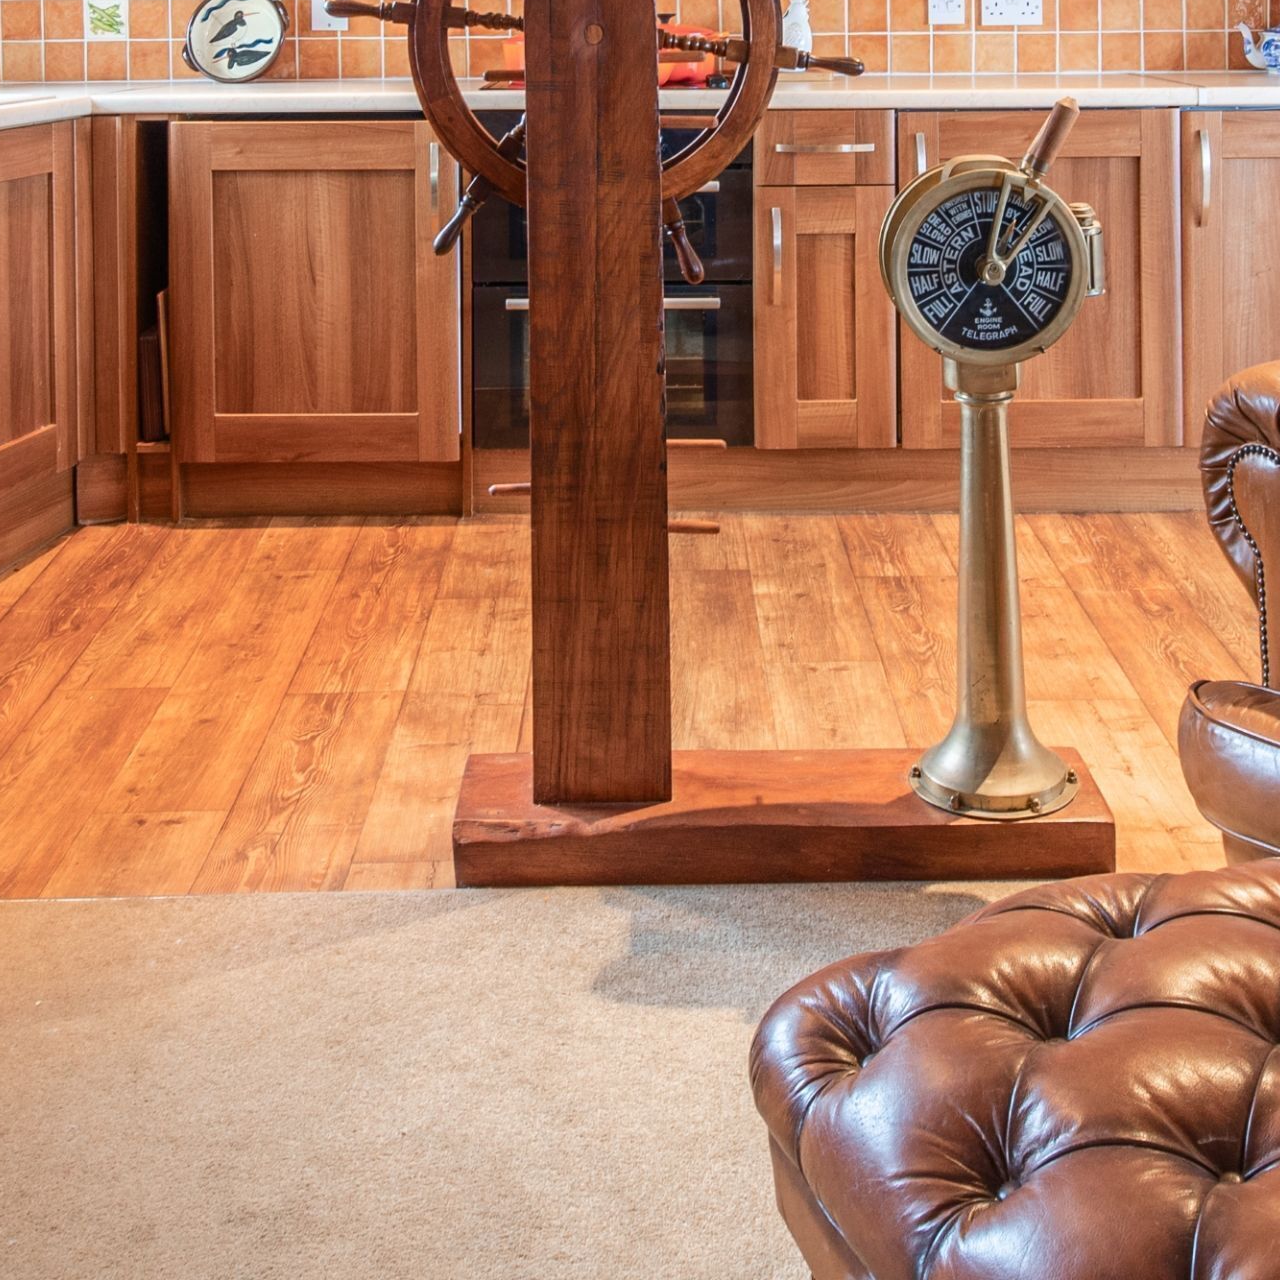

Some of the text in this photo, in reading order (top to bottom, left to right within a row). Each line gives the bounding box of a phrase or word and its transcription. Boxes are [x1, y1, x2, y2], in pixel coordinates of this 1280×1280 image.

[948, 202, 968, 216] WITH
[973, 191, 1000, 213] STOP
[1005, 207, 1021, 219] BY
[920, 222, 947, 243] SLOW
[927, 212, 952, 236] DEAD
[910, 243, 940, 265] SLOW
[943, 226, 975, 294] ASTERN
[1035, 240, 1064, 262] SLOW
[910, 273, 939, 296] HALF
[1035, 270, 1066, 292] HALF
[923, 296, 954, 324] FULL
[1023, 292, 1052, 322] FULL
[961, 324, 1018, 340] TELEGRAPH
